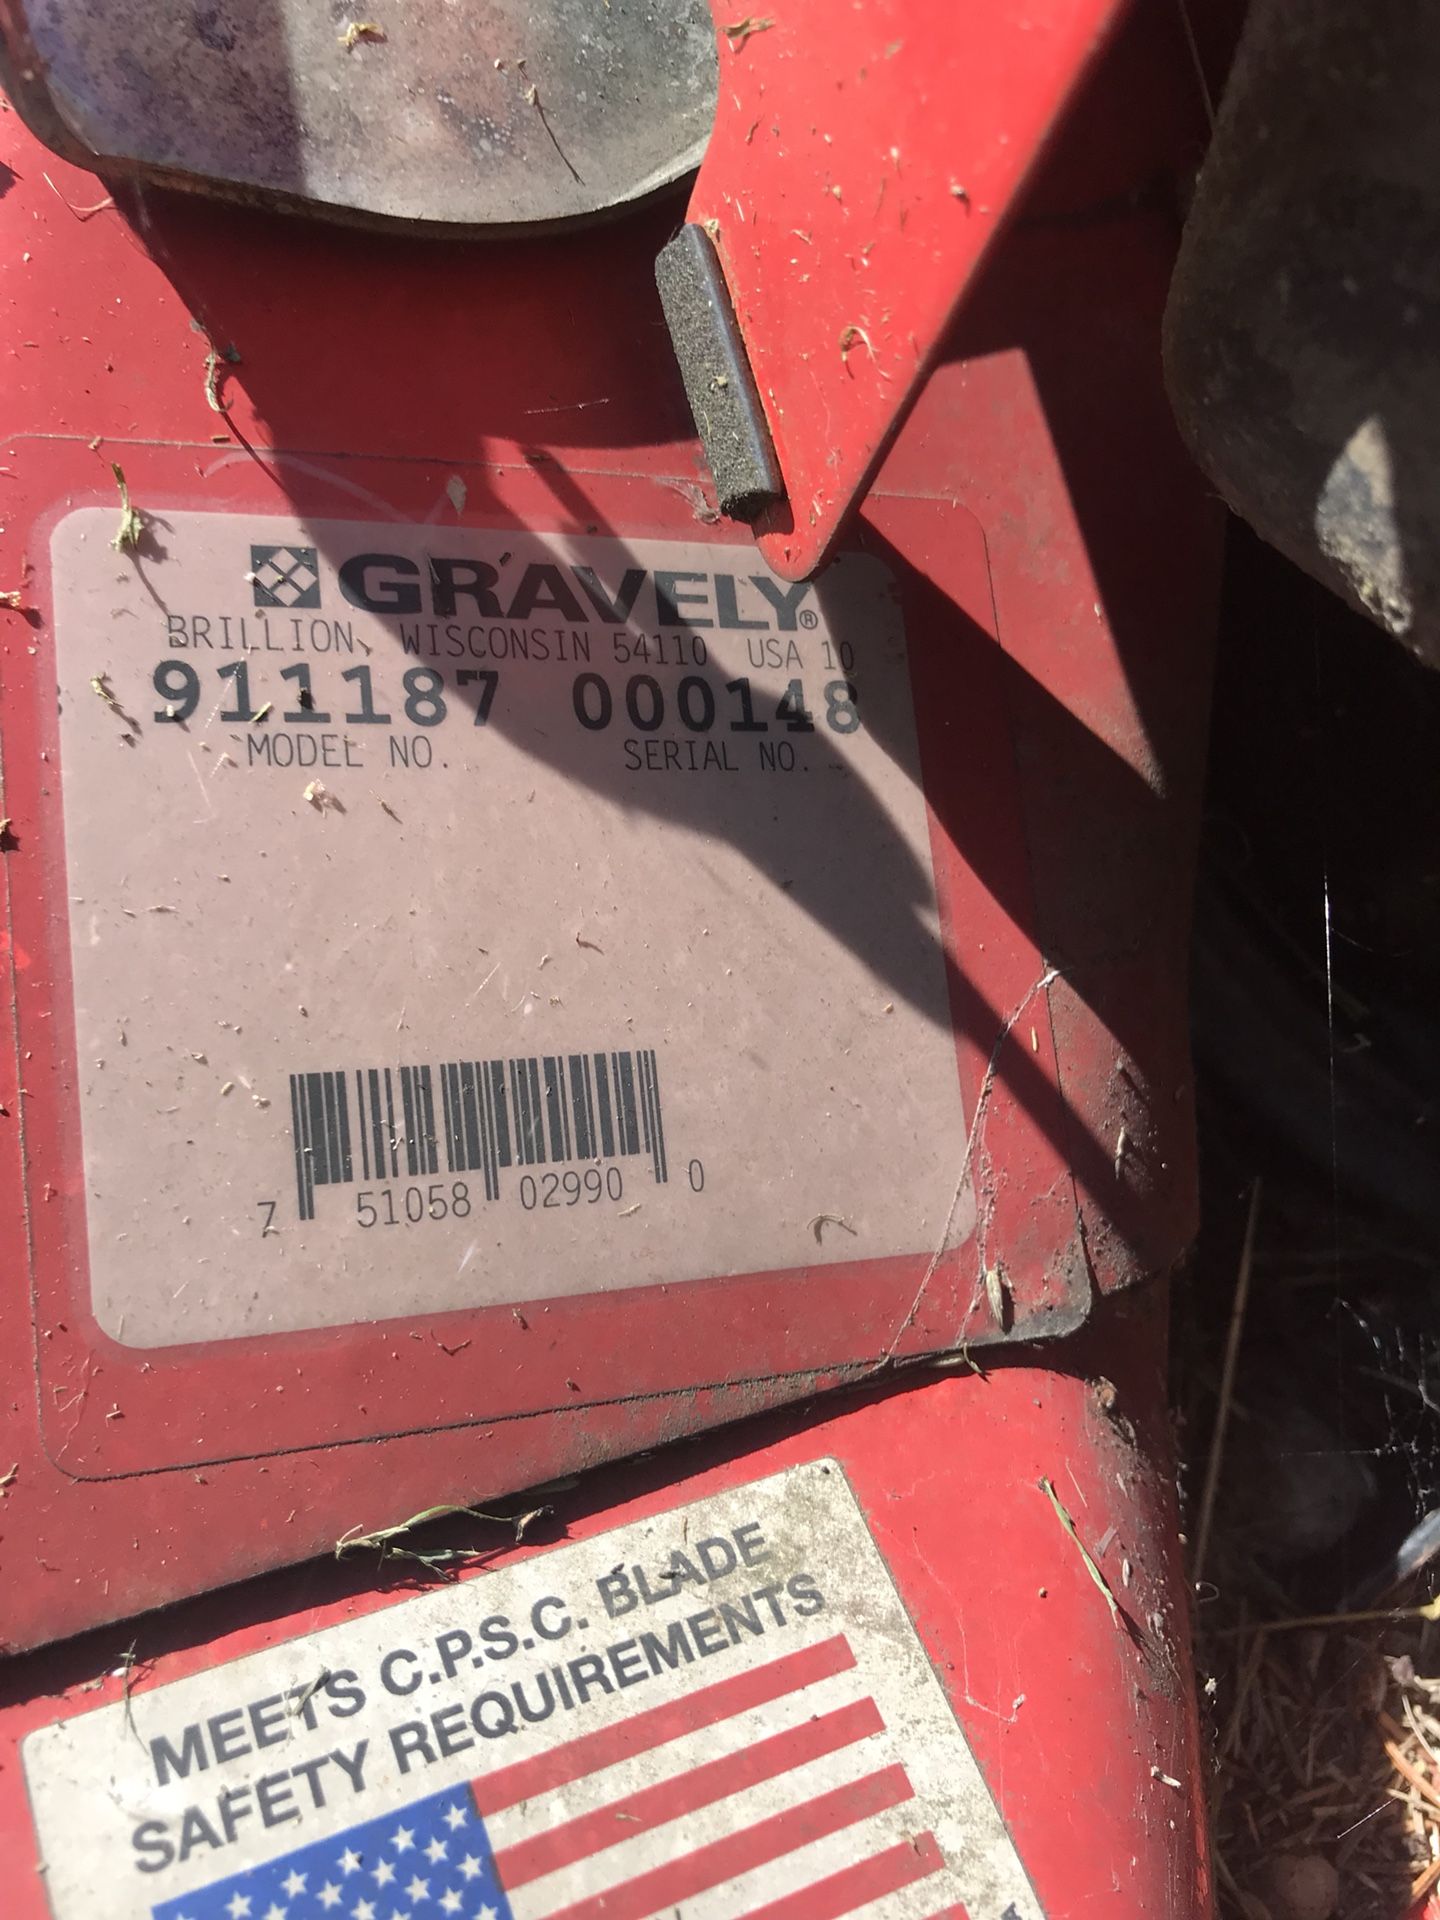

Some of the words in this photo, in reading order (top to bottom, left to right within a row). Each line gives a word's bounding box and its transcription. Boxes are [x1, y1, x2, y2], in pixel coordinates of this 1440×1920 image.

[399, 622, 590, 662] WISCONSIN
[613, 632, 707, 666] 54110
[747, 638, 803, 669] USA
[153, 660, 499, 727] 911187
[572, 672, 861, 735] 000148
[247, 733, 363, 767] MODEL
[389, 735, 449, 768] NO.
[624, 739, 739, 771] SERIAL
[759, 741, 809, 772] NO.
[257, 1201, 277, 1237] 7
[357, 1182, 472, 1228] 51058
[519, 1167, 623, 1211] 02990
[687, 1159, 706, 1193] 0
[149, 1669, 367, 1787] MEETS
[380, 1596, 589, 1696] C.P.S.C.
[596, 1521, 772, 1620] BLADE
[131, 1738, 370, 1873] SAFETY
[388, 1573, 826, 1775] REQUIREMENTS
